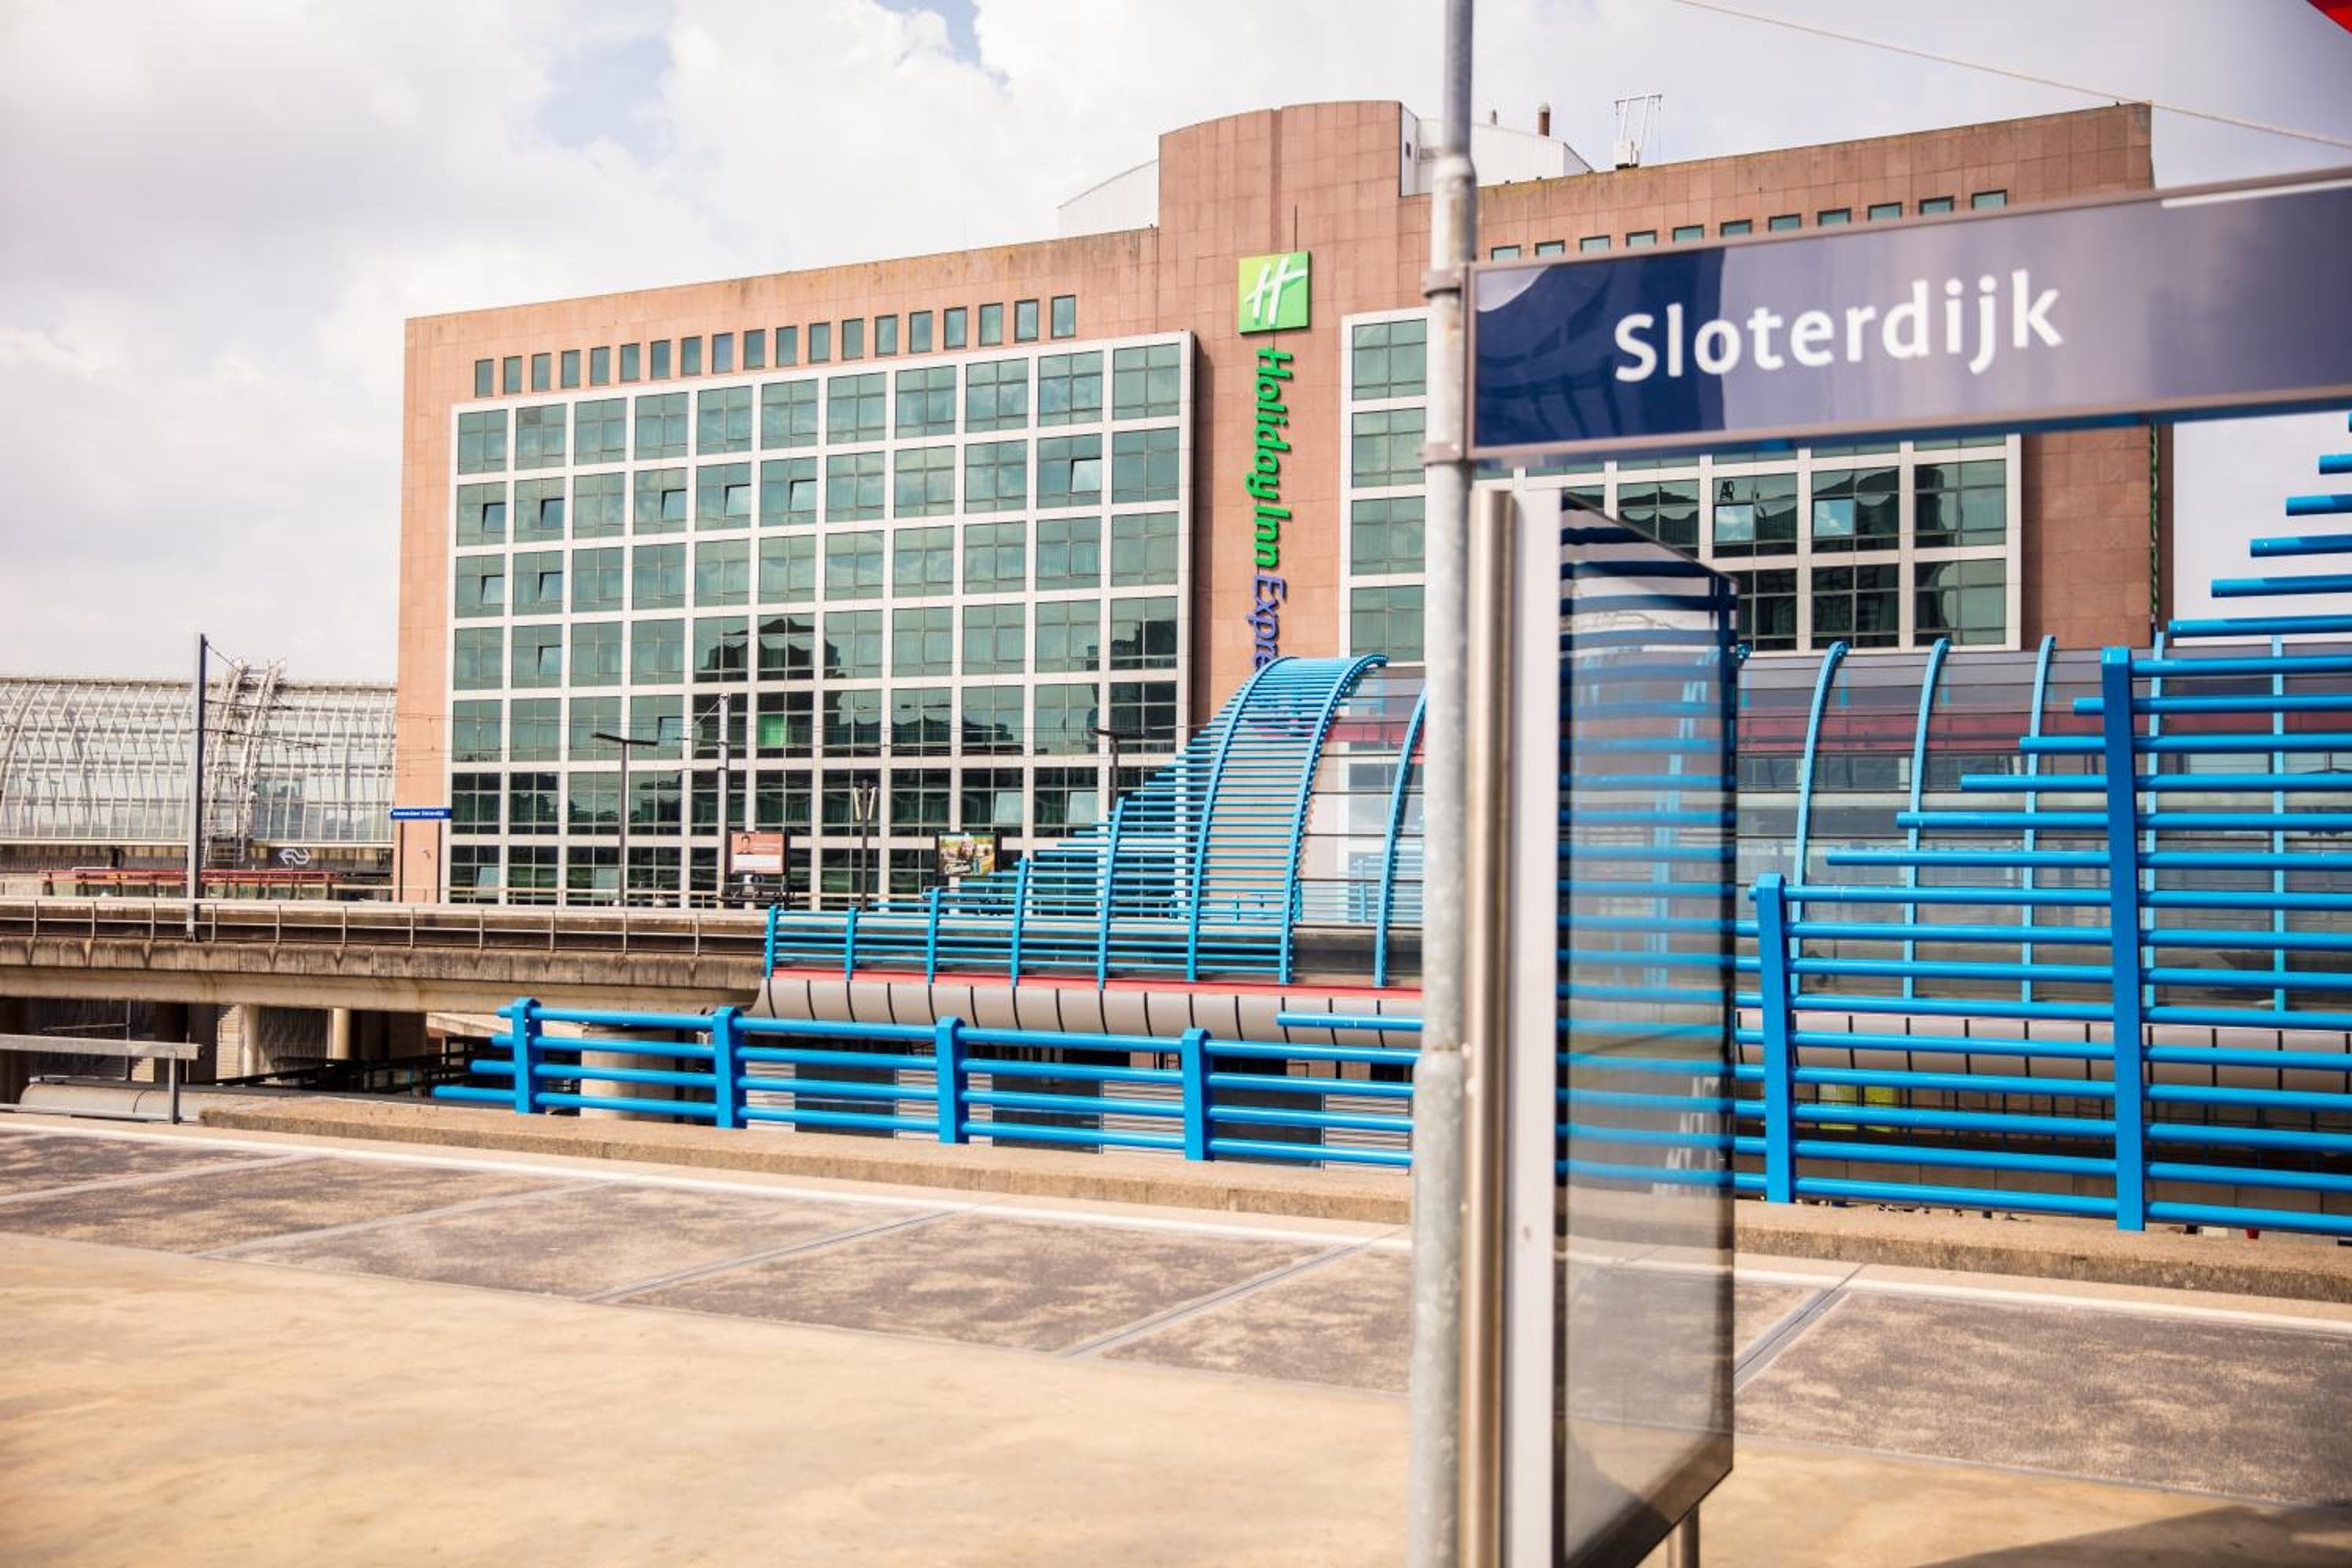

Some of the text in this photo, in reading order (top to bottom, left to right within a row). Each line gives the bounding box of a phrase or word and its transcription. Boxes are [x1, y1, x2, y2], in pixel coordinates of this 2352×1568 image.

[1613, 269, 2064, 383] Sloterdijk
[1244, 347, 1294, 673] Holiday Inn Expre
